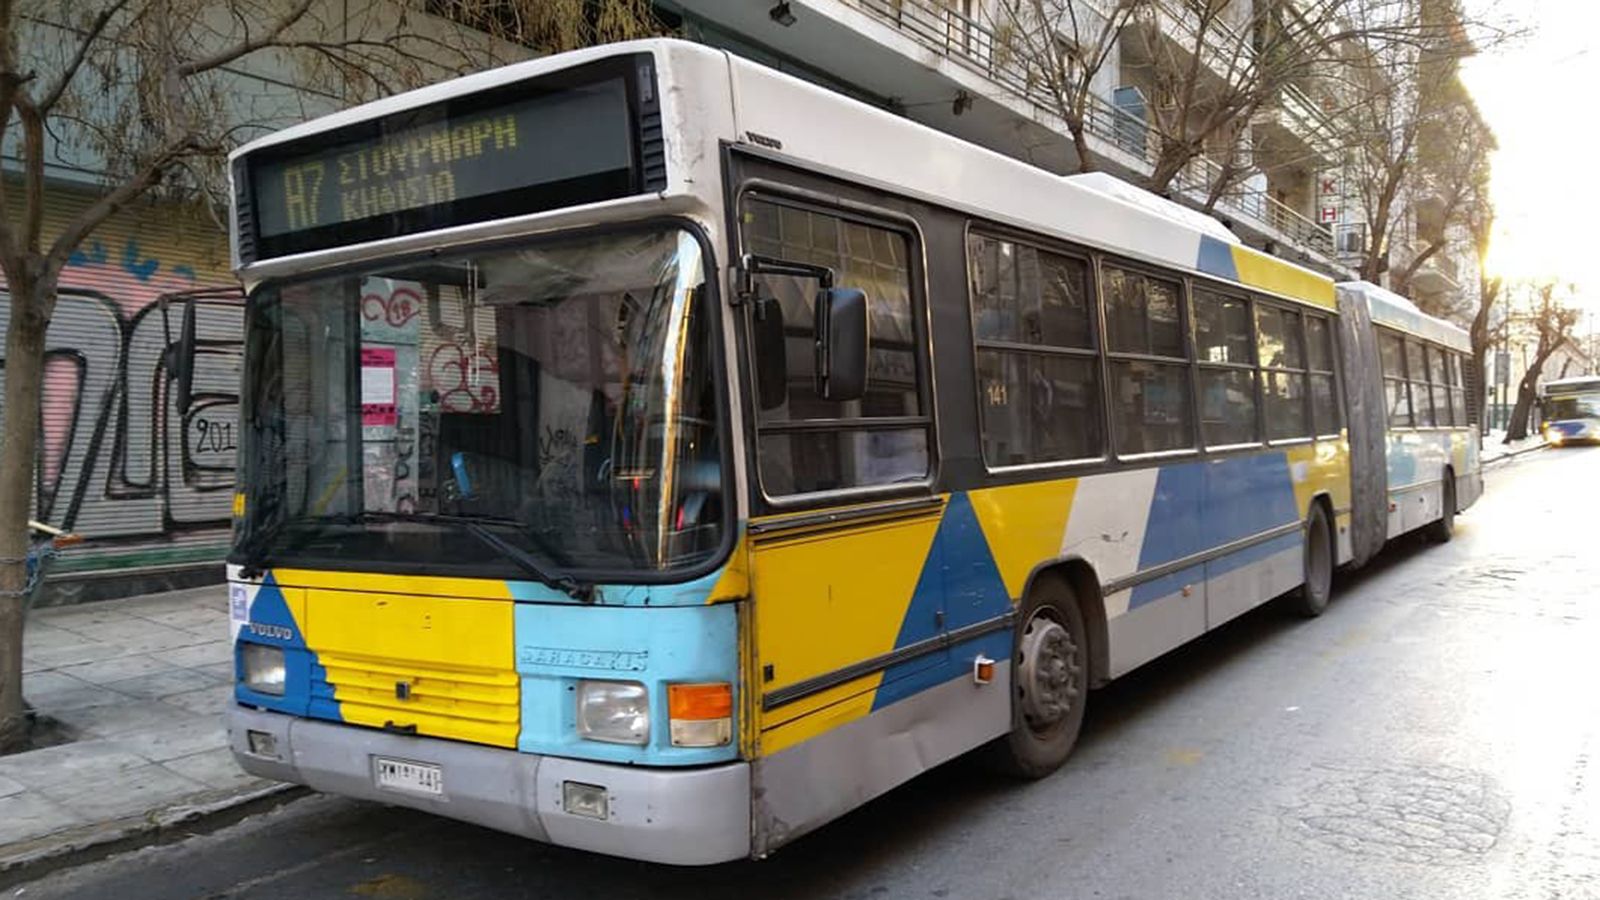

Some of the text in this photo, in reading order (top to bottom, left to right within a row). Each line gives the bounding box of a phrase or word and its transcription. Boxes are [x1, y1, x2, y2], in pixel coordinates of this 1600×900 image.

[745, 131, 782, 150] VOLVO
[987, 384, 1007, 405] 141
[250, 622, 292, 640] VOLVO
